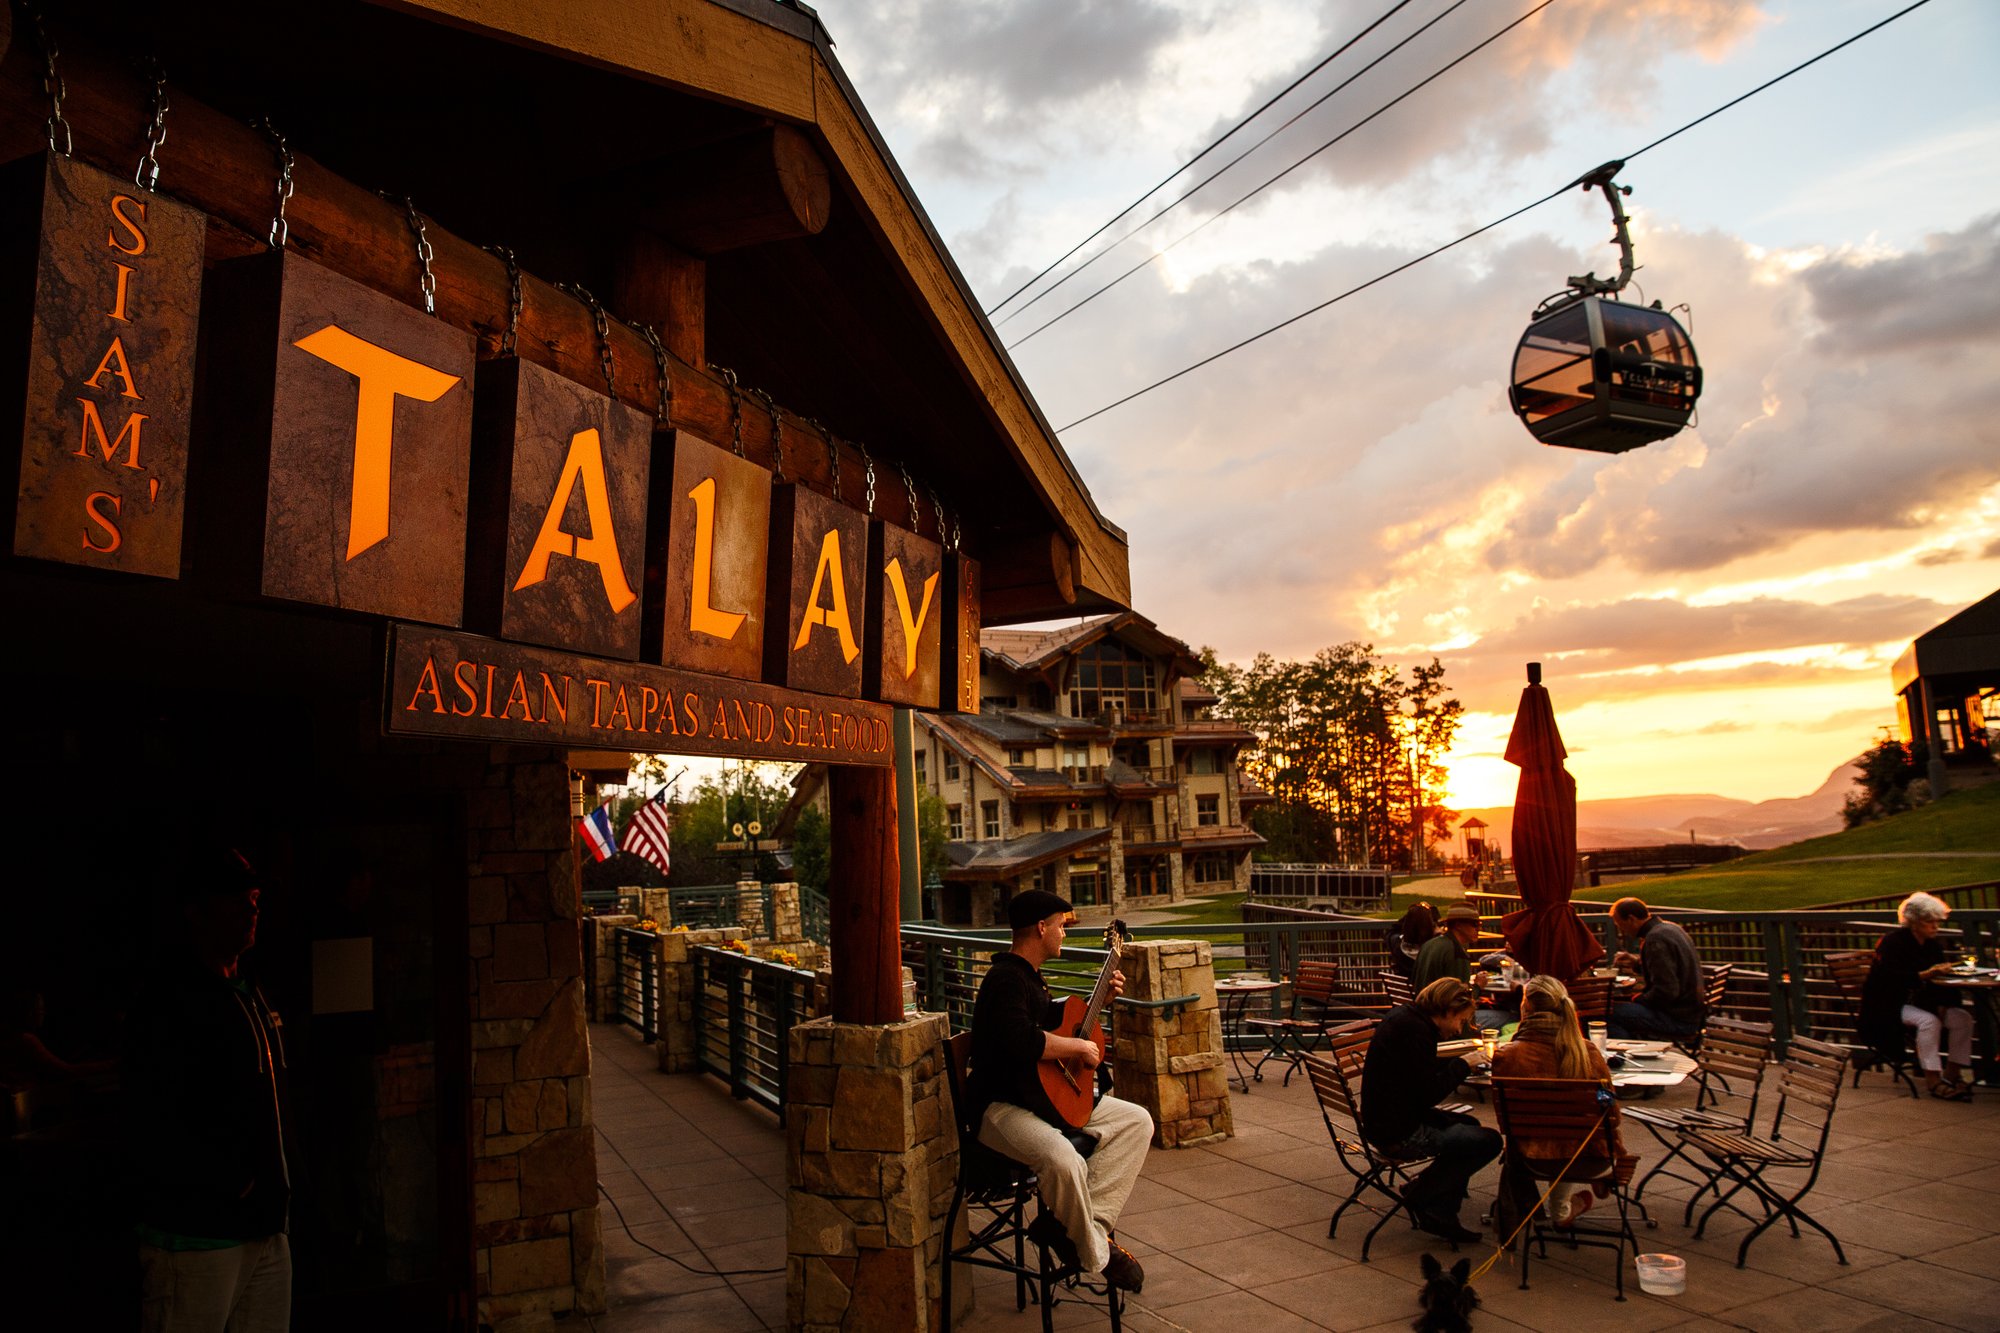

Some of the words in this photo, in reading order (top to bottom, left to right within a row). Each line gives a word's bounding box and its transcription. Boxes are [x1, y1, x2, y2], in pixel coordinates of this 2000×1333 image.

[72, 193, 161, 554] SIAM'S
[293, 323, 940, 682] TALAY
[406, 655, 574, 726] ASIAN
[586, 679, 700, 738] TAPAS
[708, 697, 775, 743] AND
[783, 706, 889, 753] SEAFOOD
